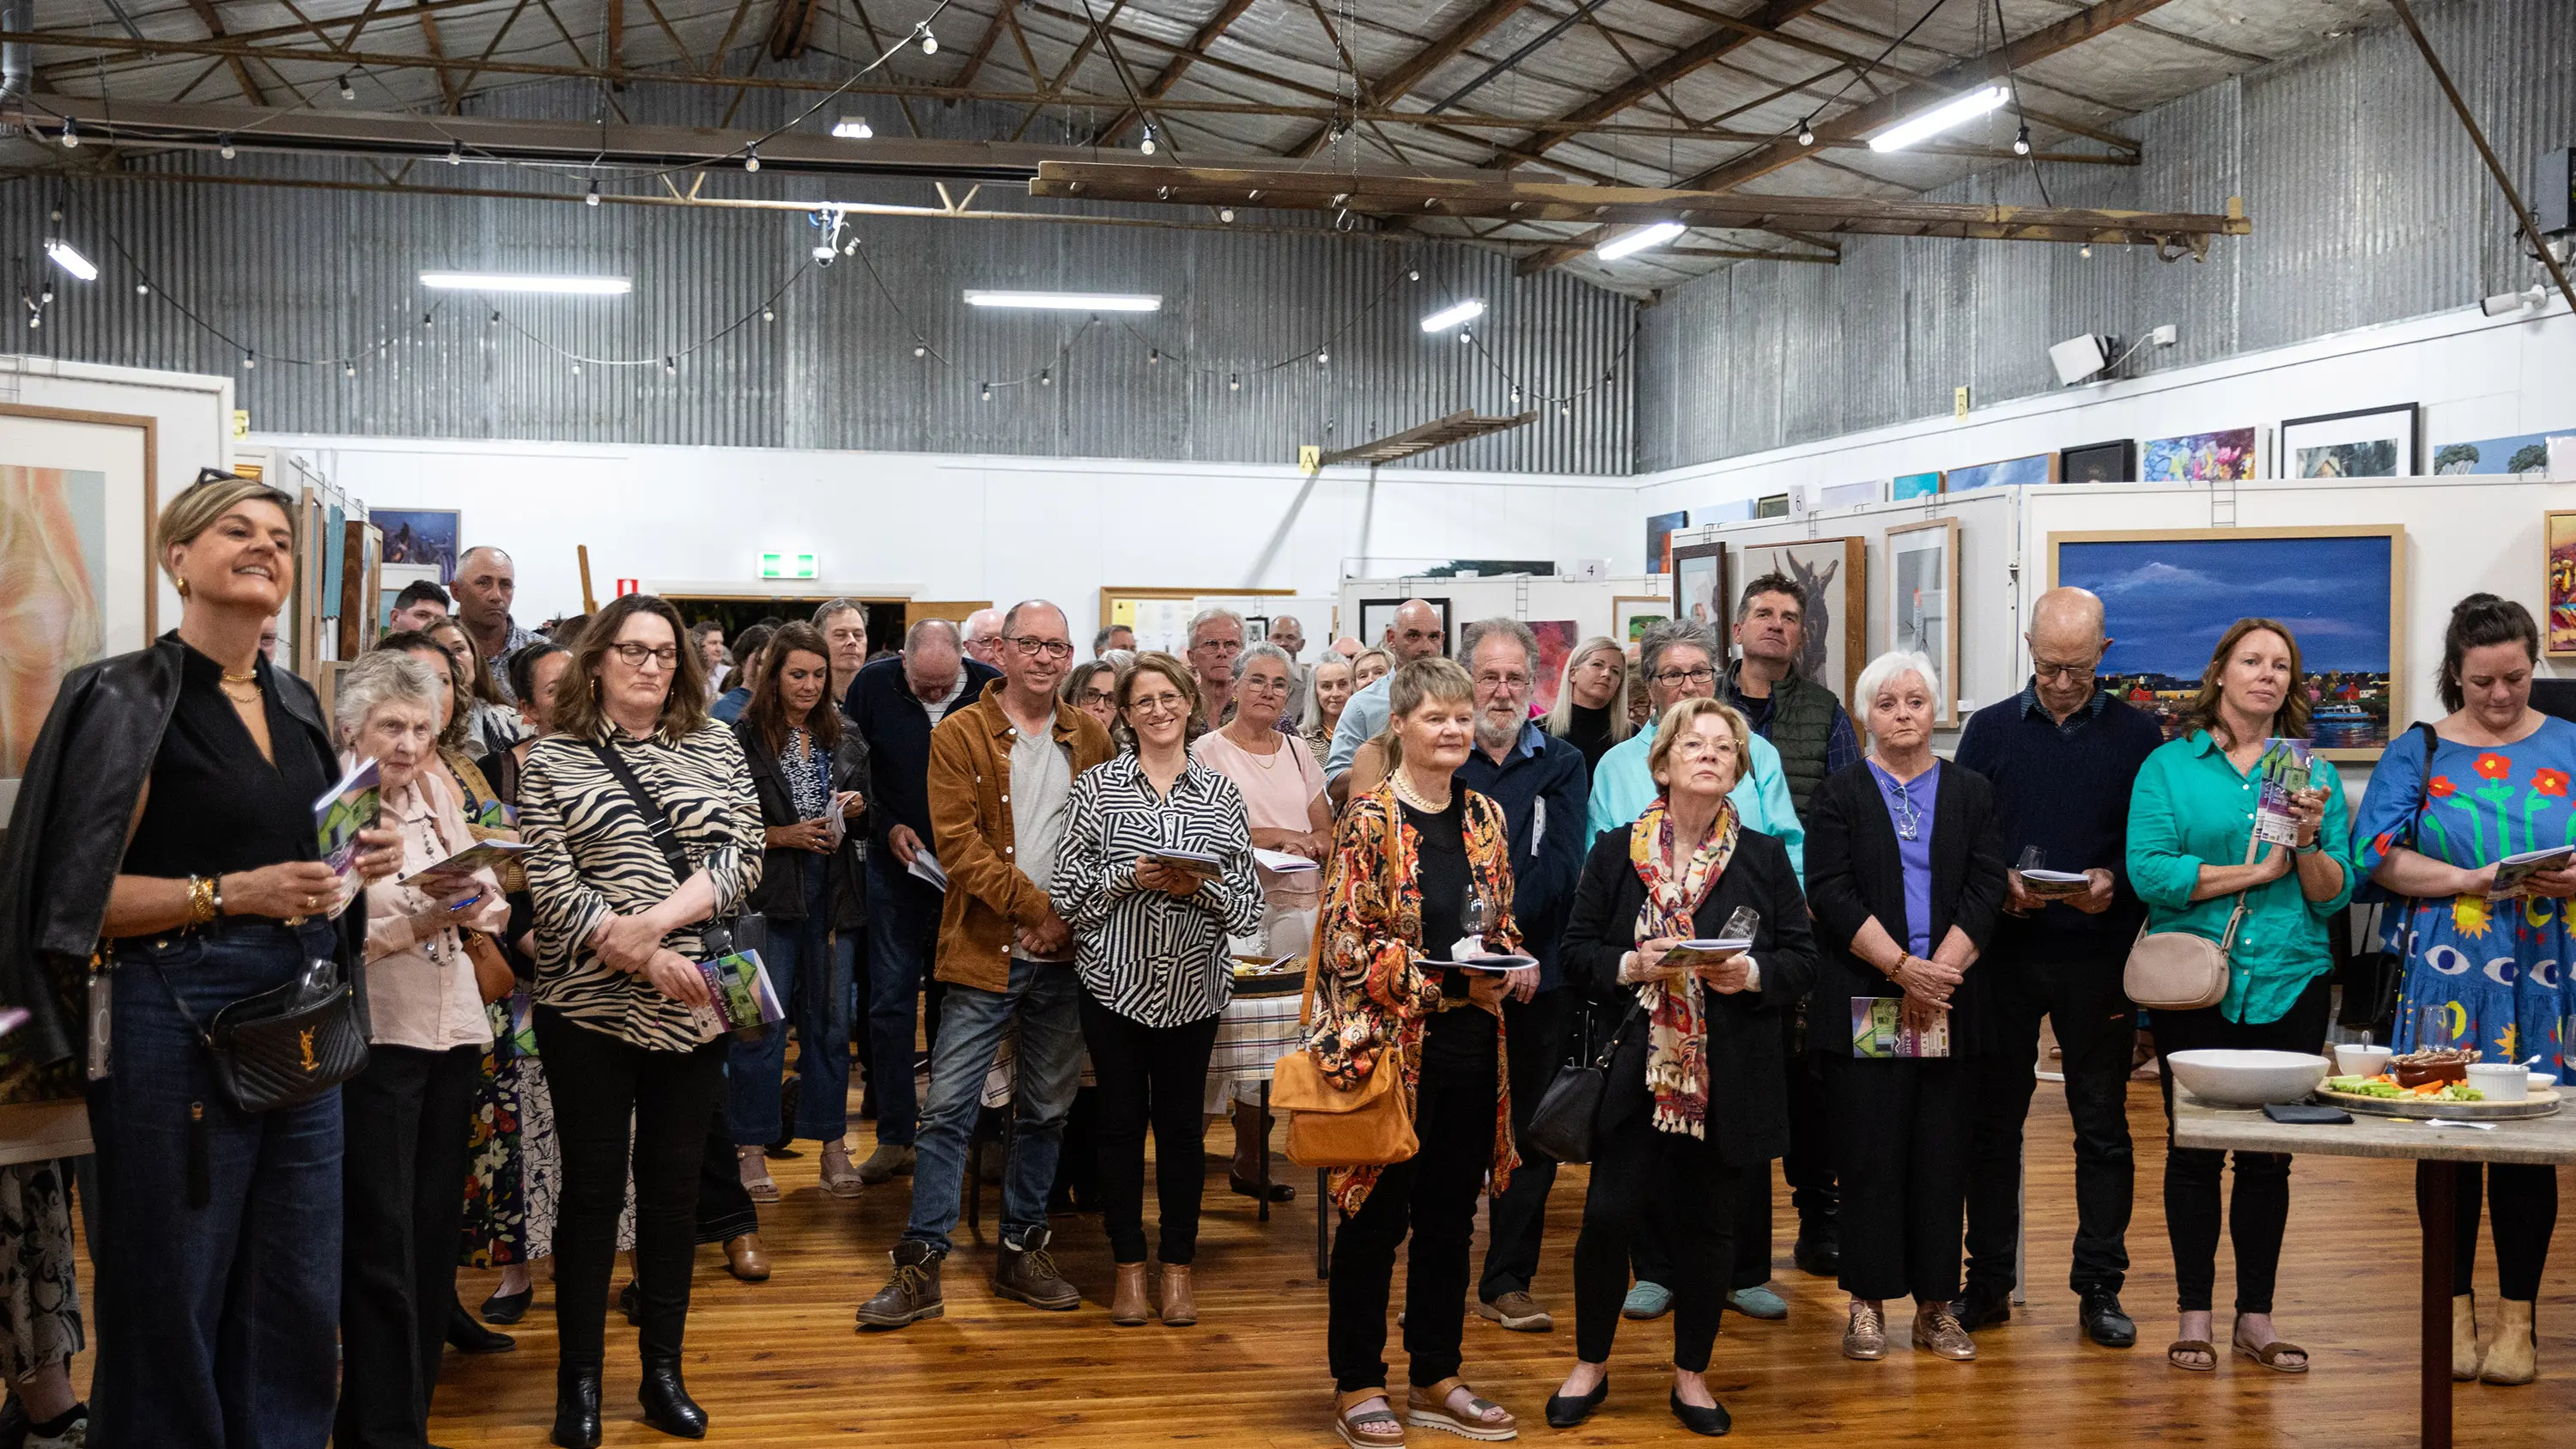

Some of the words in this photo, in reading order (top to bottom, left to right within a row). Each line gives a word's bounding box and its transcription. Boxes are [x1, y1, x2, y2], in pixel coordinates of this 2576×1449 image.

[1958, 394, 1966, 416] B
[1302, 451, 1316, 468] A
[1795, 494, 1802, 512] 6
[1587, 564, 1595, 576] 4
